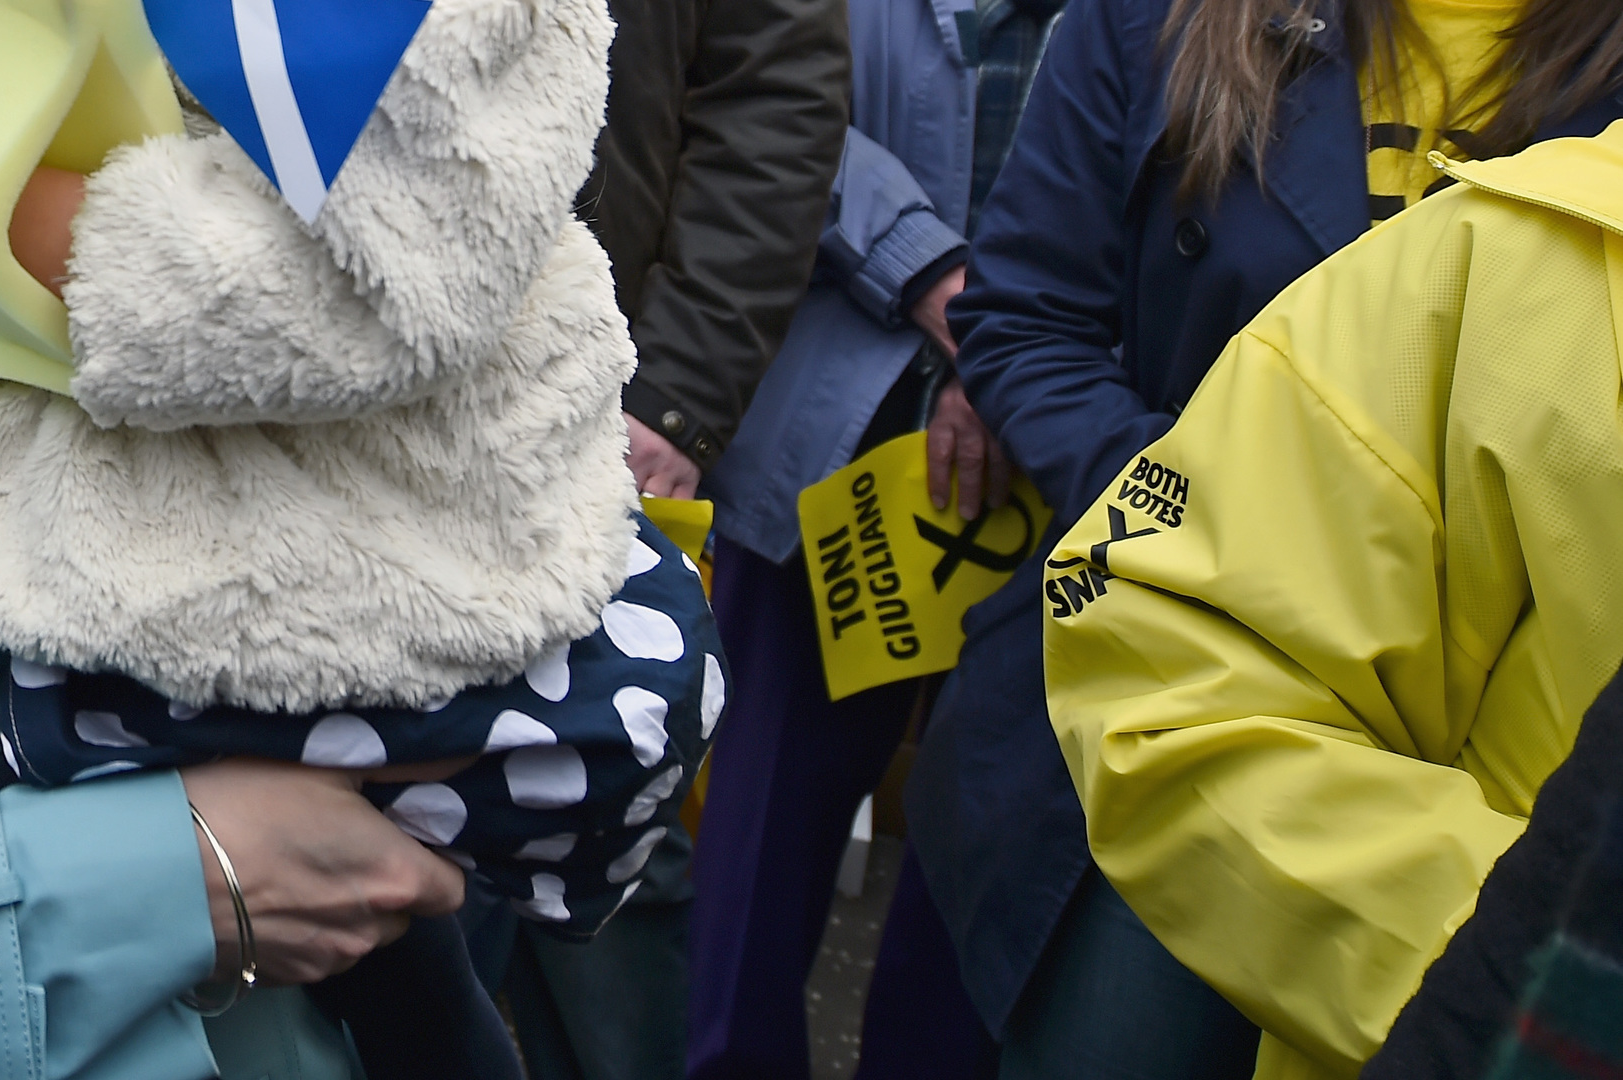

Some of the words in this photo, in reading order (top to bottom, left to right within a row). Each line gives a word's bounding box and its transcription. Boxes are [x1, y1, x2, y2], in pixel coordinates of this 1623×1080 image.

[1117, 479, 1185, 528] VOTES
[1128, 456, 1189, 505] BOTH
[818, 525, 865, 641] TONI
[851, 471, 922, 660] GIUGLIANO
